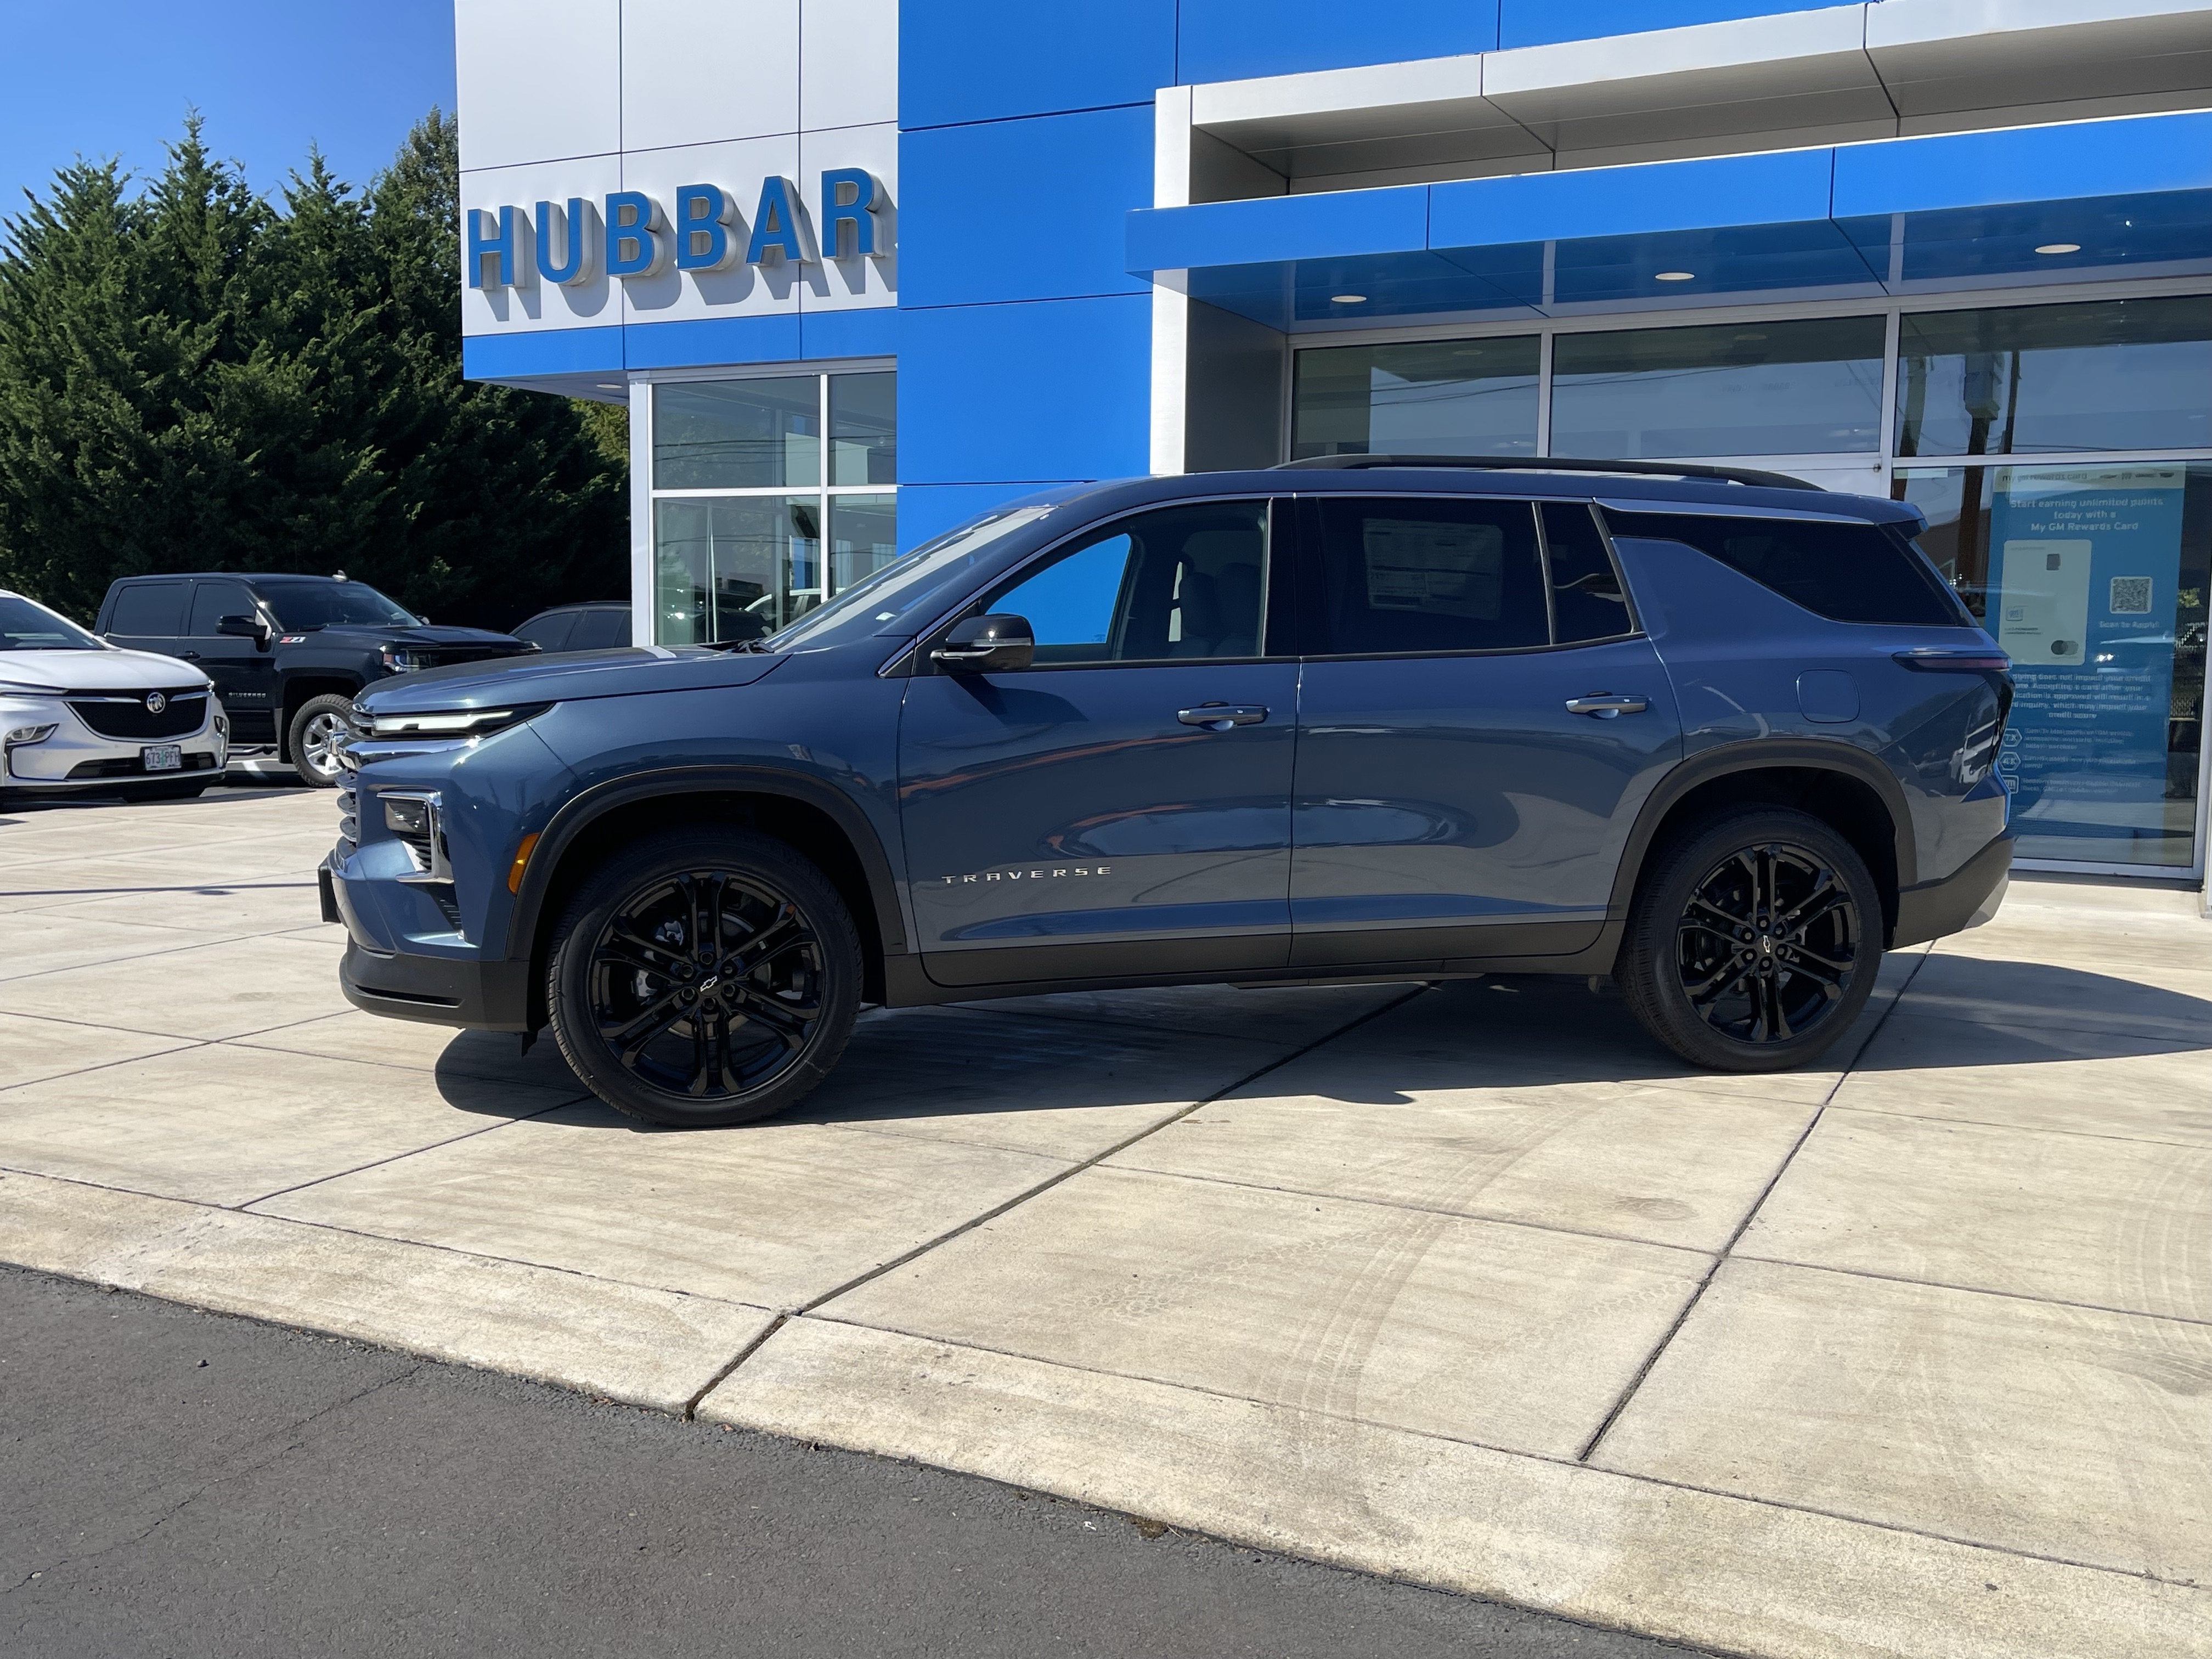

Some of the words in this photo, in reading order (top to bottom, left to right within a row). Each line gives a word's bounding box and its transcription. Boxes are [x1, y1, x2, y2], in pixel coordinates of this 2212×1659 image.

[2011, 500, 2035, 508] Start
[2038, 499, 2077, 509] earning
[2079, 498, 2129, 507] unlimited
[2130, 496, 2164, 508] points
[2053, 511, 2083, 520] today
[2086, 510, 2108, 519] with
[2031, 523, 2046, 533] My
[2049, 522, 2065, 531] GM
[2067, 522, 2111, 531] Rewards
[2114, 521, 2138, 531] Card
[146, 752, 161, 765] 673
[165, 751, 180, 763] PFH
[941, 866, 1112, 884] TRAVERSE
